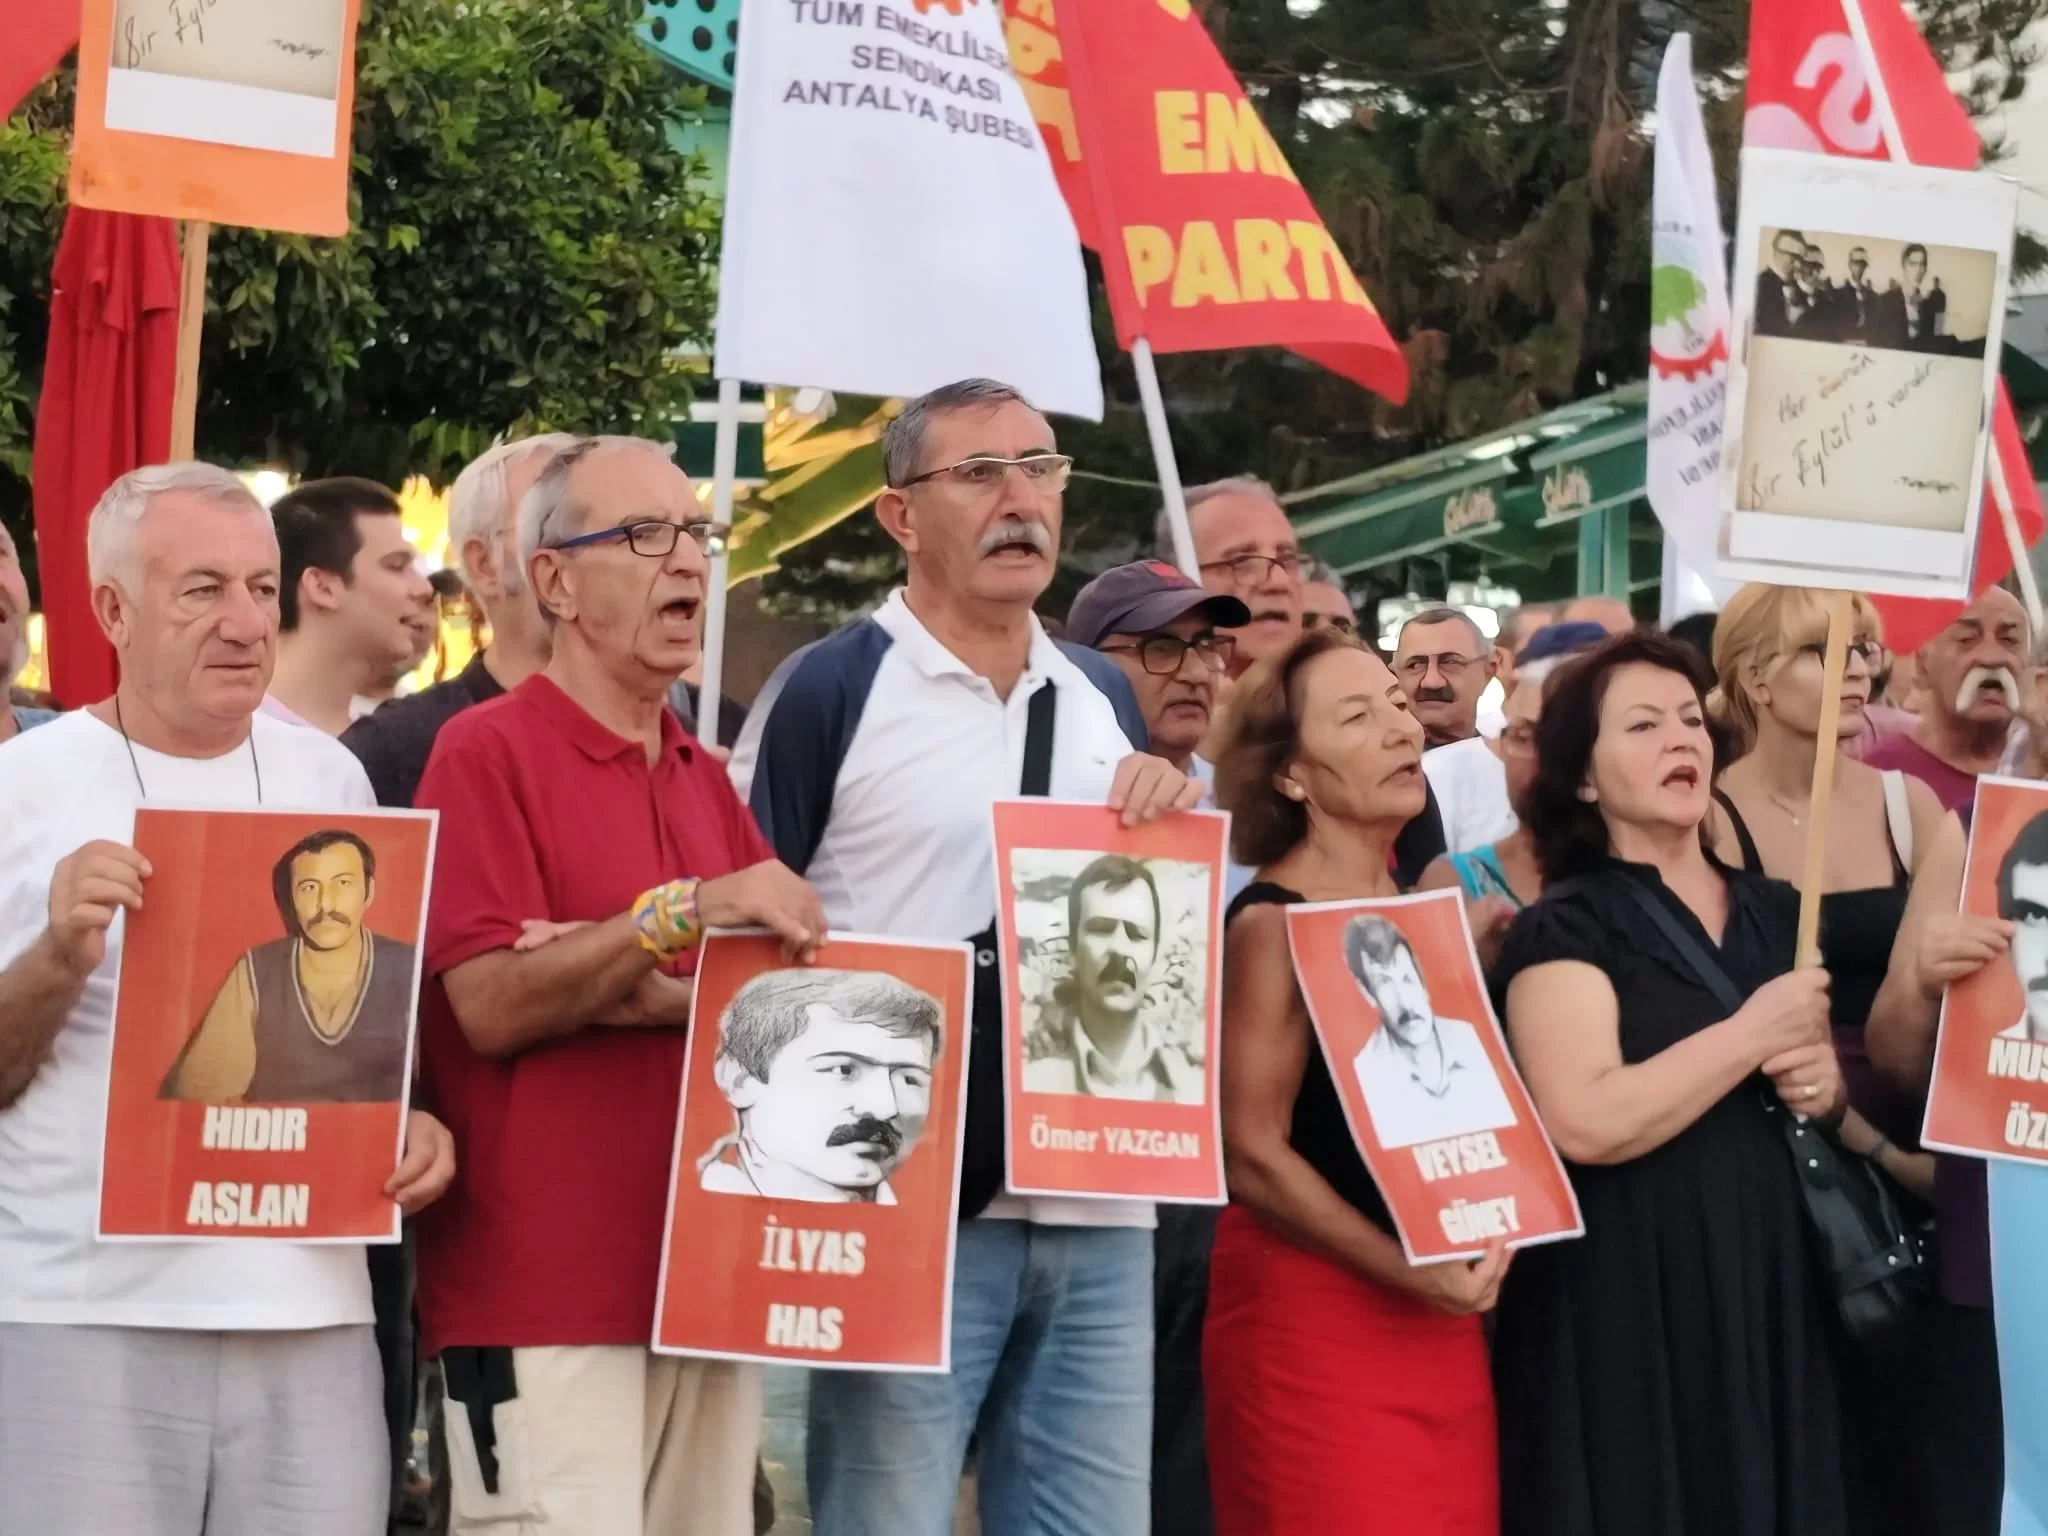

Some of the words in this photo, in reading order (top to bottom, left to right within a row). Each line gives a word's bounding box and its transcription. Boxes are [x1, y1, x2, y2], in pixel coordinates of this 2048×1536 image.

[783, 80, 939, 122] ANTALYA
[203, 1105, 308, 1151] HIDIR
[1030, 1114, 1098, 1153] Ömer
[1103, 1127, 1200, 1158] YAZGAN
[2005, 1101, 2048, 1151] ÖZ
[1412, 1131, 1508, 1183] VEYSEL
[186, 1180, 310, 1227] ASLAN
[758, 1213, 867, 1276] İLYAS
[766, 1303, 844, 1351] HAS
